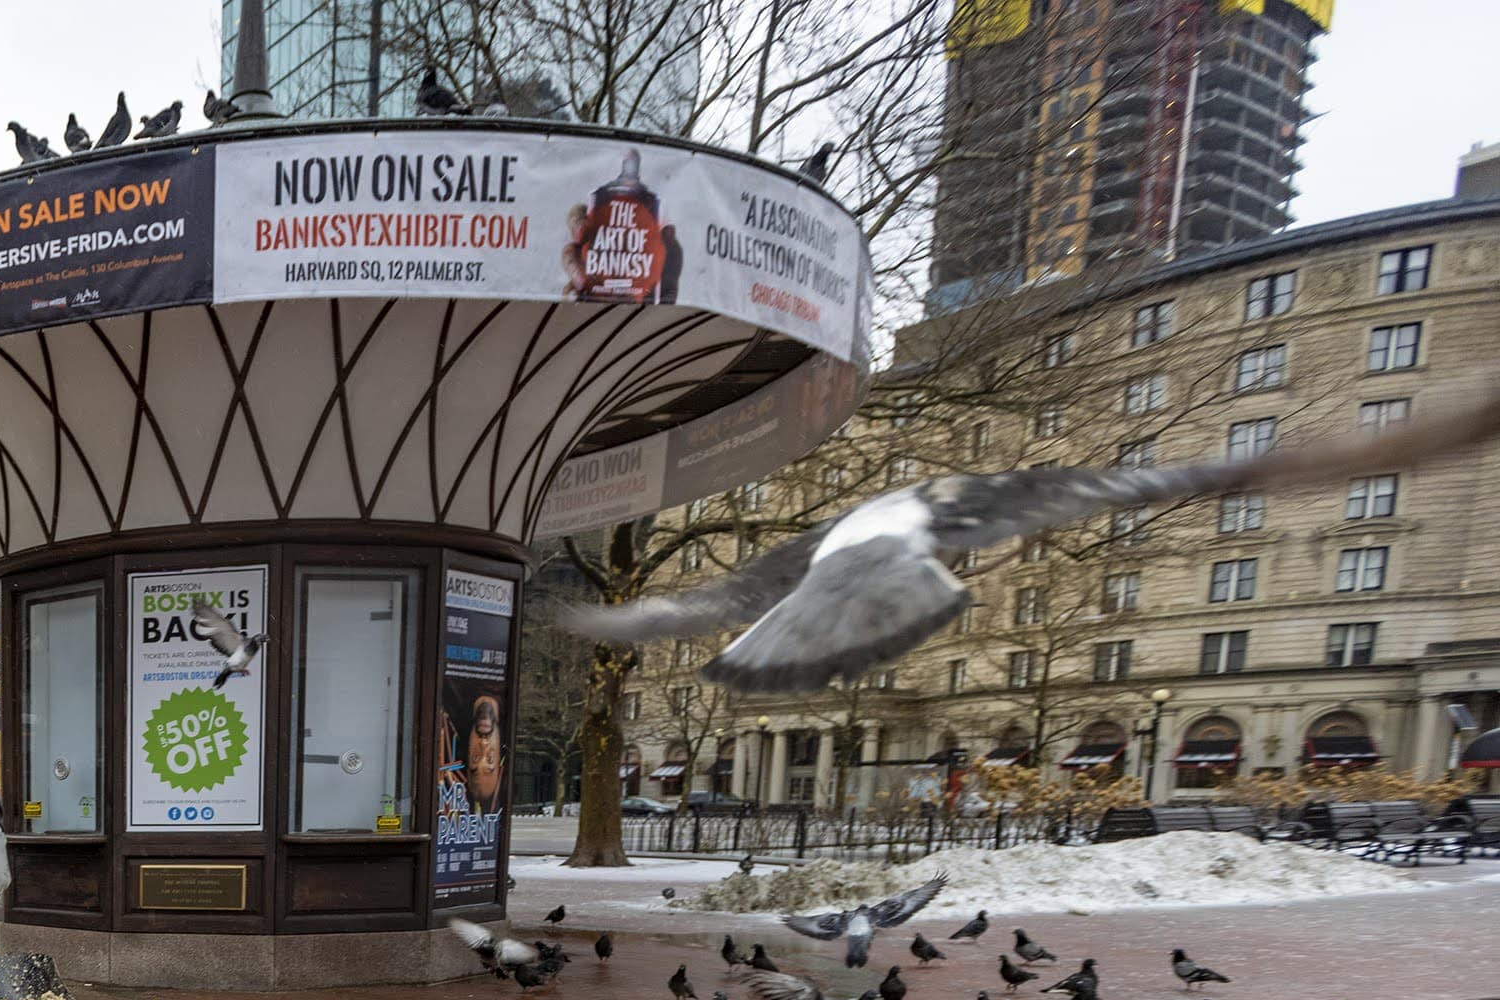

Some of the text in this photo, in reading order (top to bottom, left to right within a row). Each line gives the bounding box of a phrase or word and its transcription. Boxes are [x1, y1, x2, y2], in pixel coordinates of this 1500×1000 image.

[274, 154, 518, 206] NOW ON SALE
[18, 192, 85, 230] SALE
[94, 178, 171, 215] NOW
[609, 200, 638, 228] THE
[255, 213, 529, 251] BANKSYEXHIBIT.COM
[593, 225, 649, 253] ART OF
[45, 271, 60, 282] The
[107, 256, 149, 271] Columbus
[586, 250, 654, 278] BANKSY
[706, 223, 797, 281] COLLECTION
[798, 253, 812, 286] OF
[285, 260, 485, 282] HARVARD SQ, 12 PALMER ST.
[143, 590, 249, 613] BOSTIX IS
[144, 583, 202, 593] ARTSBOSTON
[447, 576, 511, 603] ARTSBOSTON
[166, 706, 227, 744] 50%
[166, 729, 232, 775] OFF
[437, 780, 469, 812] MR.
[437, 810, 501, 845] PARENT
